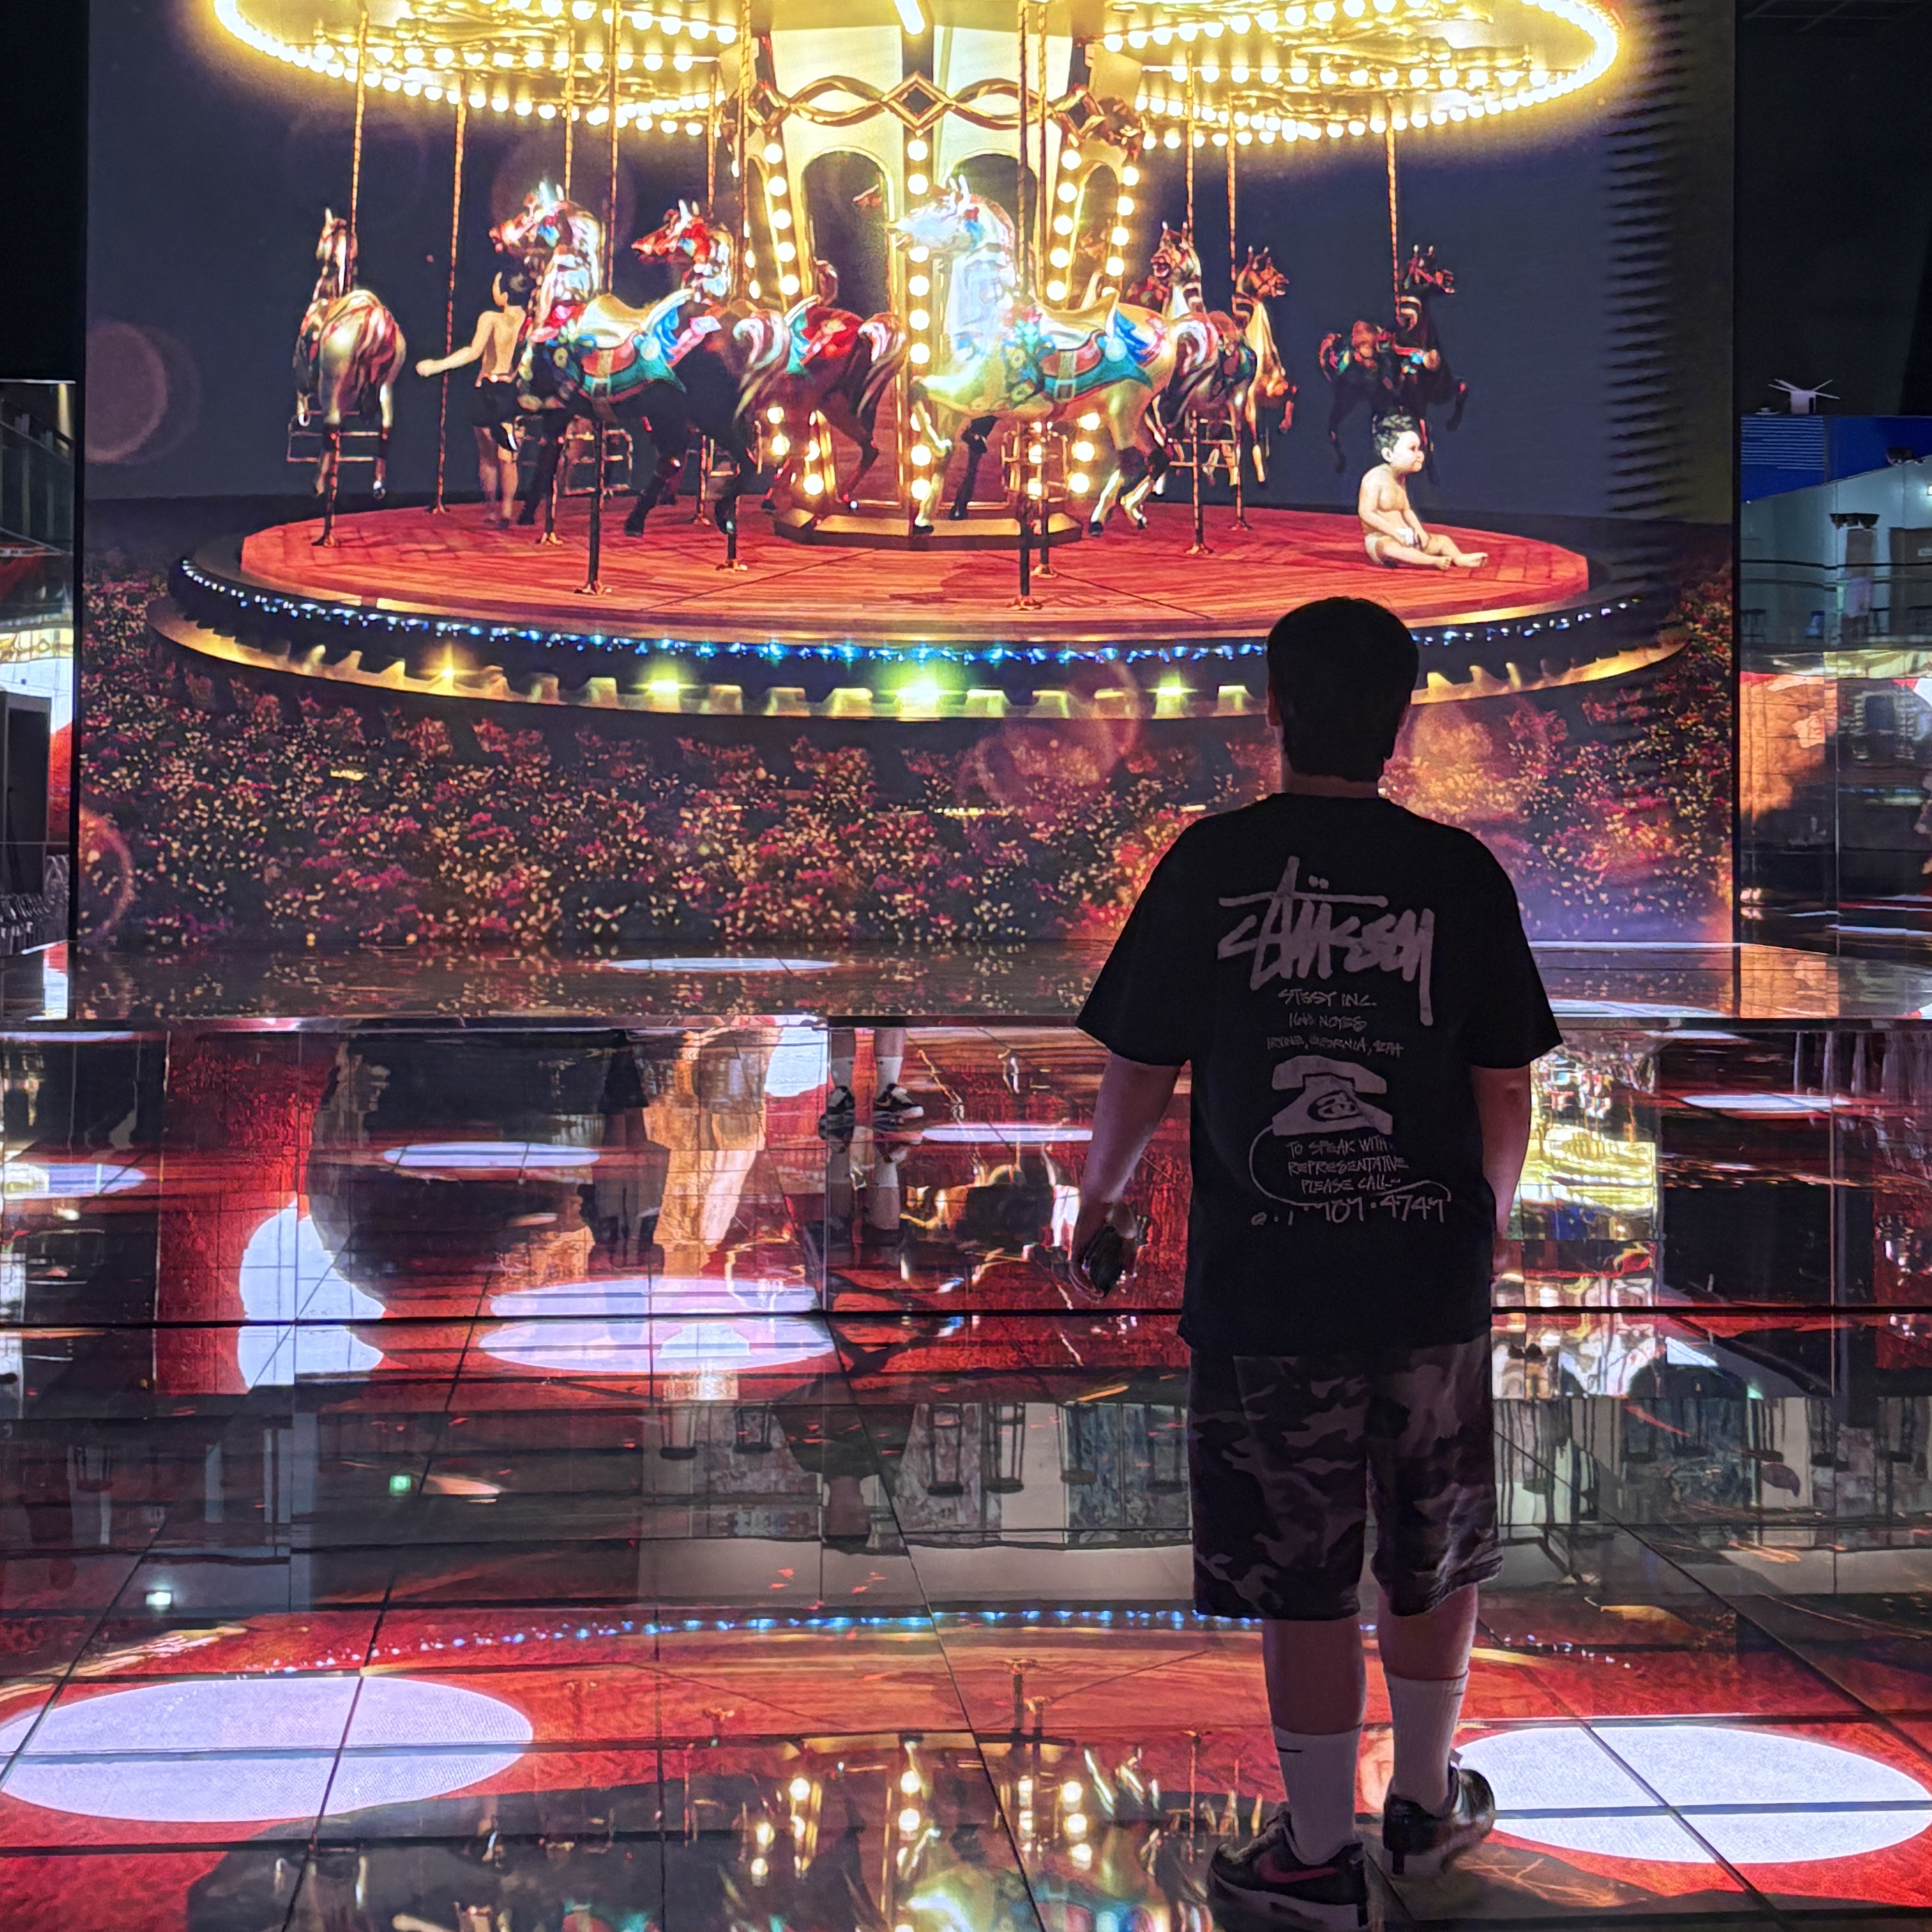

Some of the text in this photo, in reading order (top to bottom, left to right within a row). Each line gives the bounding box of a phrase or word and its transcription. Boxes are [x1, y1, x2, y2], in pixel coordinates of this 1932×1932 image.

[1286, 1141, 1303, 1158] TO
[1308, 1139, 1356, 1156] SPEAK
[1301, 1178, 1354, 1194] PLEASE
